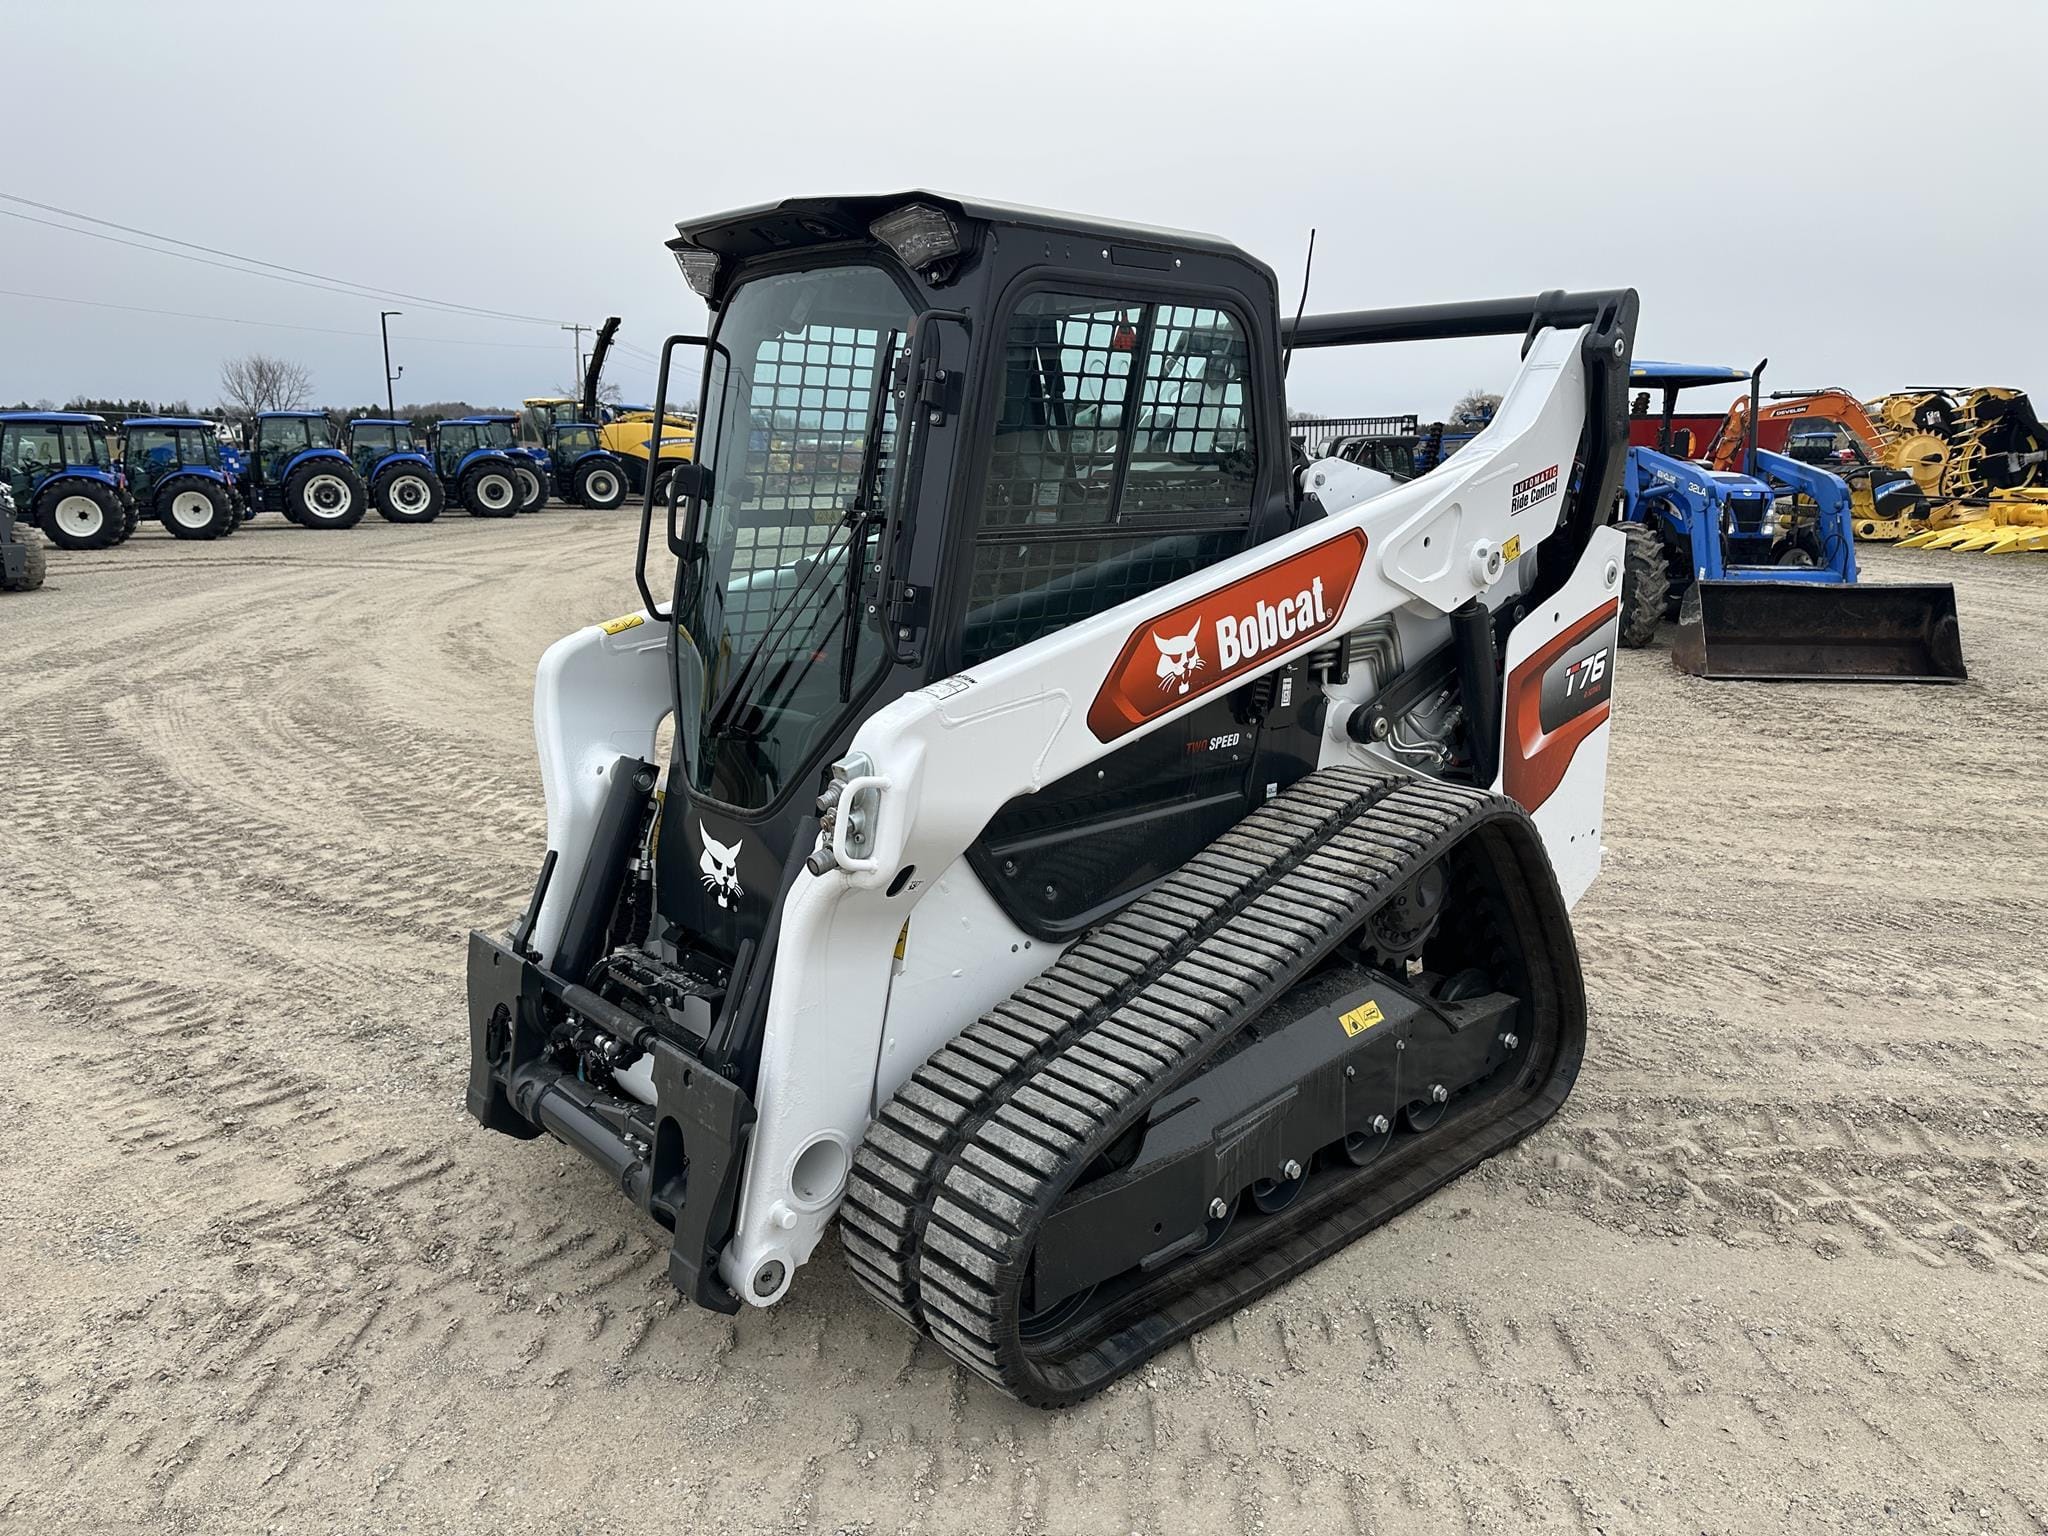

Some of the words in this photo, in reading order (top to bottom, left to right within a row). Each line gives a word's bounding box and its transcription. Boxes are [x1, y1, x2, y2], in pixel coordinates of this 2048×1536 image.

[1776, 406, 1807, 416] DEVELON
[1511, 494, 1529, 513] Ride
[1530, 478, 1558, 503] Control
[1514, 467, 1557, 495] AUTOMATIC
[1215, 576, 1326, 671] Bobcat
[1565, 647, 1608, 698] T76
[1186, 739, 1208, 754] TWO
[1209, 732, 1240, 751] SPEED
